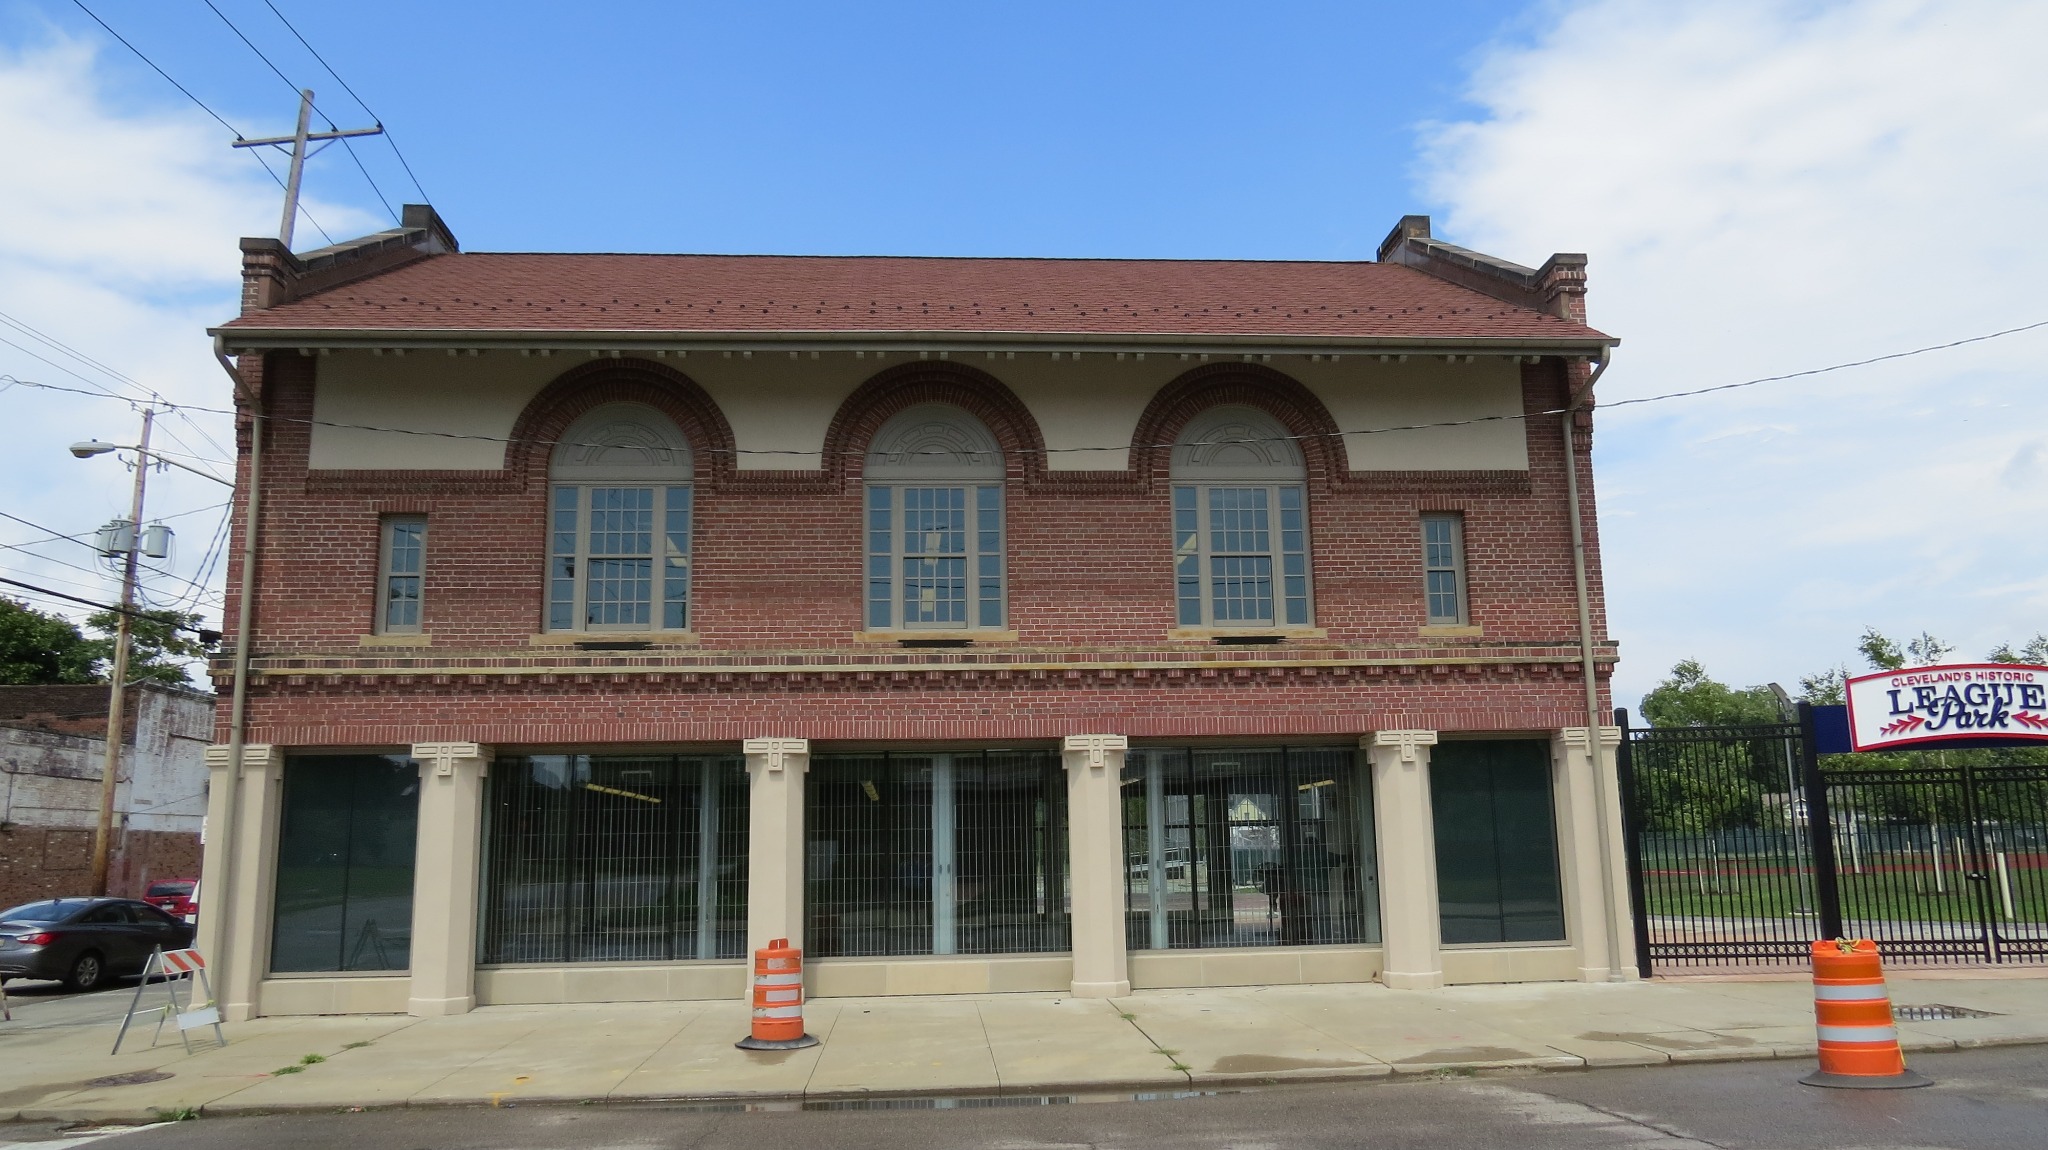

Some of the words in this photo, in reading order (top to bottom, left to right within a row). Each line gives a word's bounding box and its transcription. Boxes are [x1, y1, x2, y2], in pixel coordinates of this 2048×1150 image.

[1891, 671, 1972, 688] CLEVELAND'S
[1976, 671, 2034, 683] HISTORIC
[1886, 683, 2047, 716] LEAGUE
[1924, 695, 2010, 731] Park
